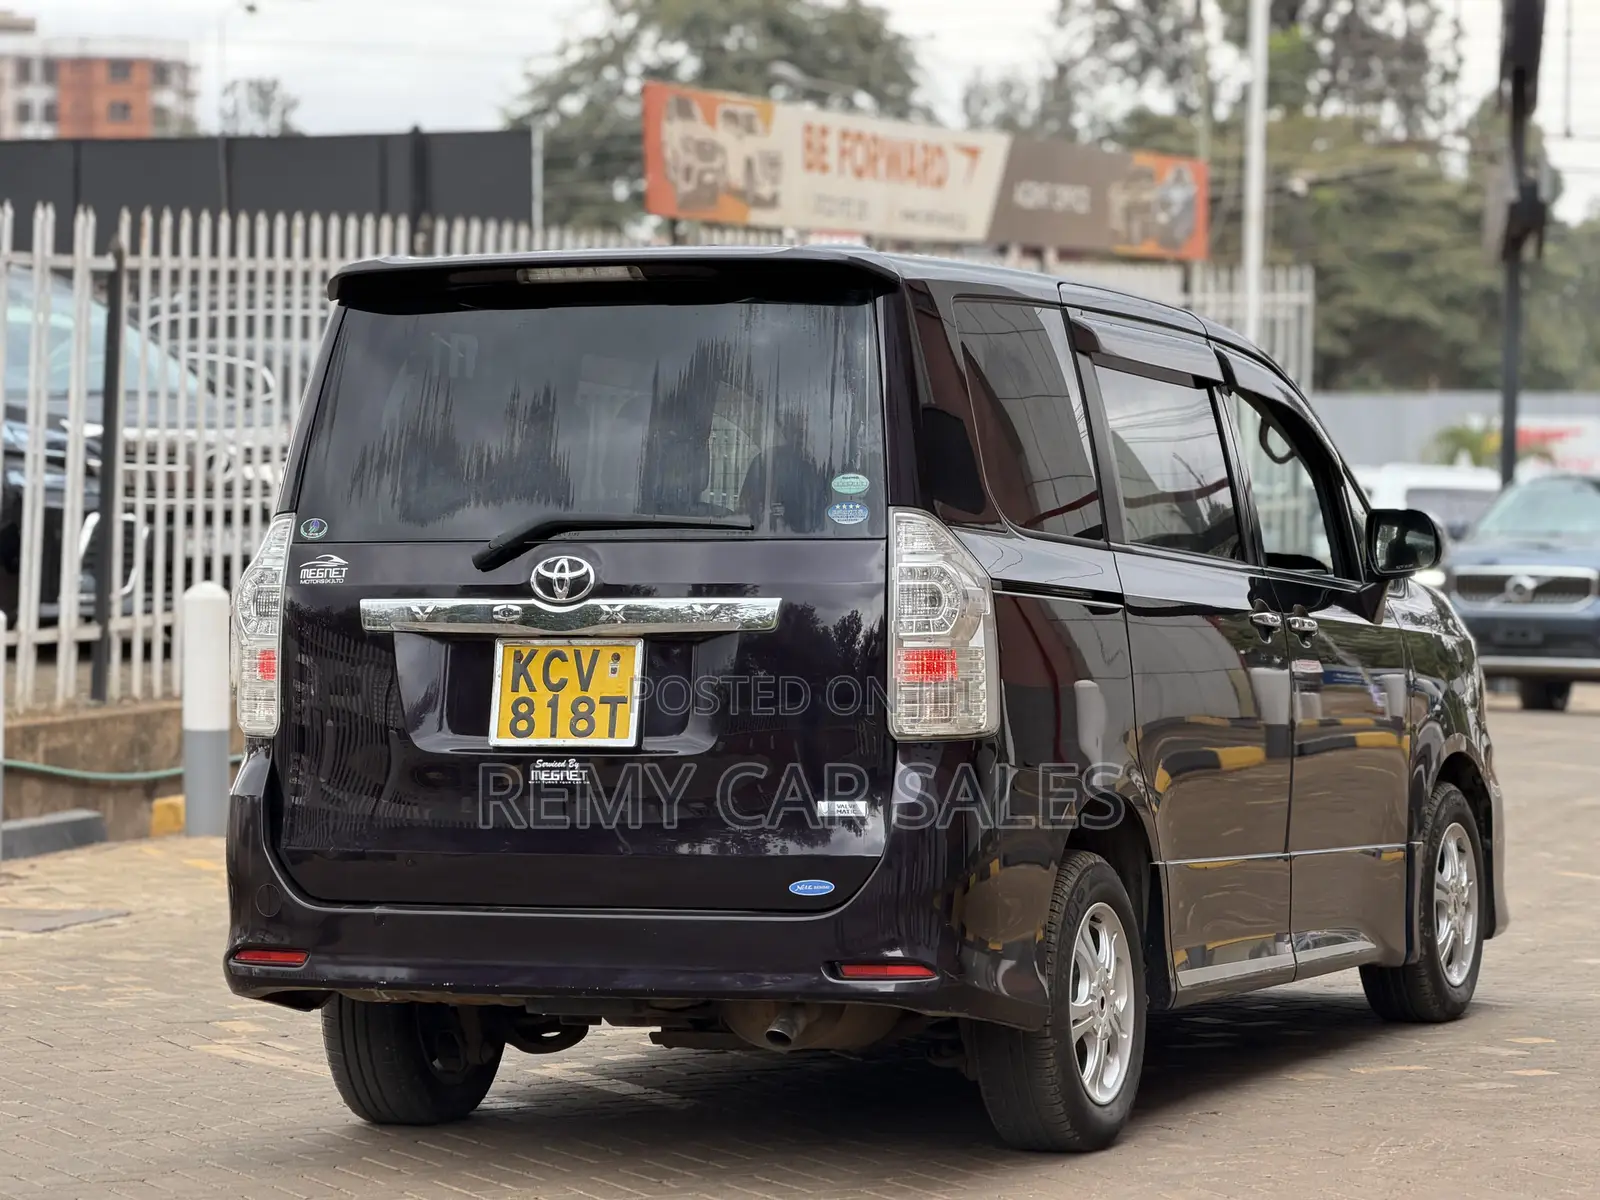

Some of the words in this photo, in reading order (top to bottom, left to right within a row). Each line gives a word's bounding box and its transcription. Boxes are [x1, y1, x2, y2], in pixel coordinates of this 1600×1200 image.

[801, 121, 831, 174] BE
[837, 127, 950, 189] FORWARD
[299, 567, 349, 579] MEGNET
[510, 648, 601, 693] KCV
[508, 693, 629, 739] 818T
[530, 769, 589, 781] MEGNET
[535, 758, 567, 768] Serviced
[568, 758, 580, 770] By
